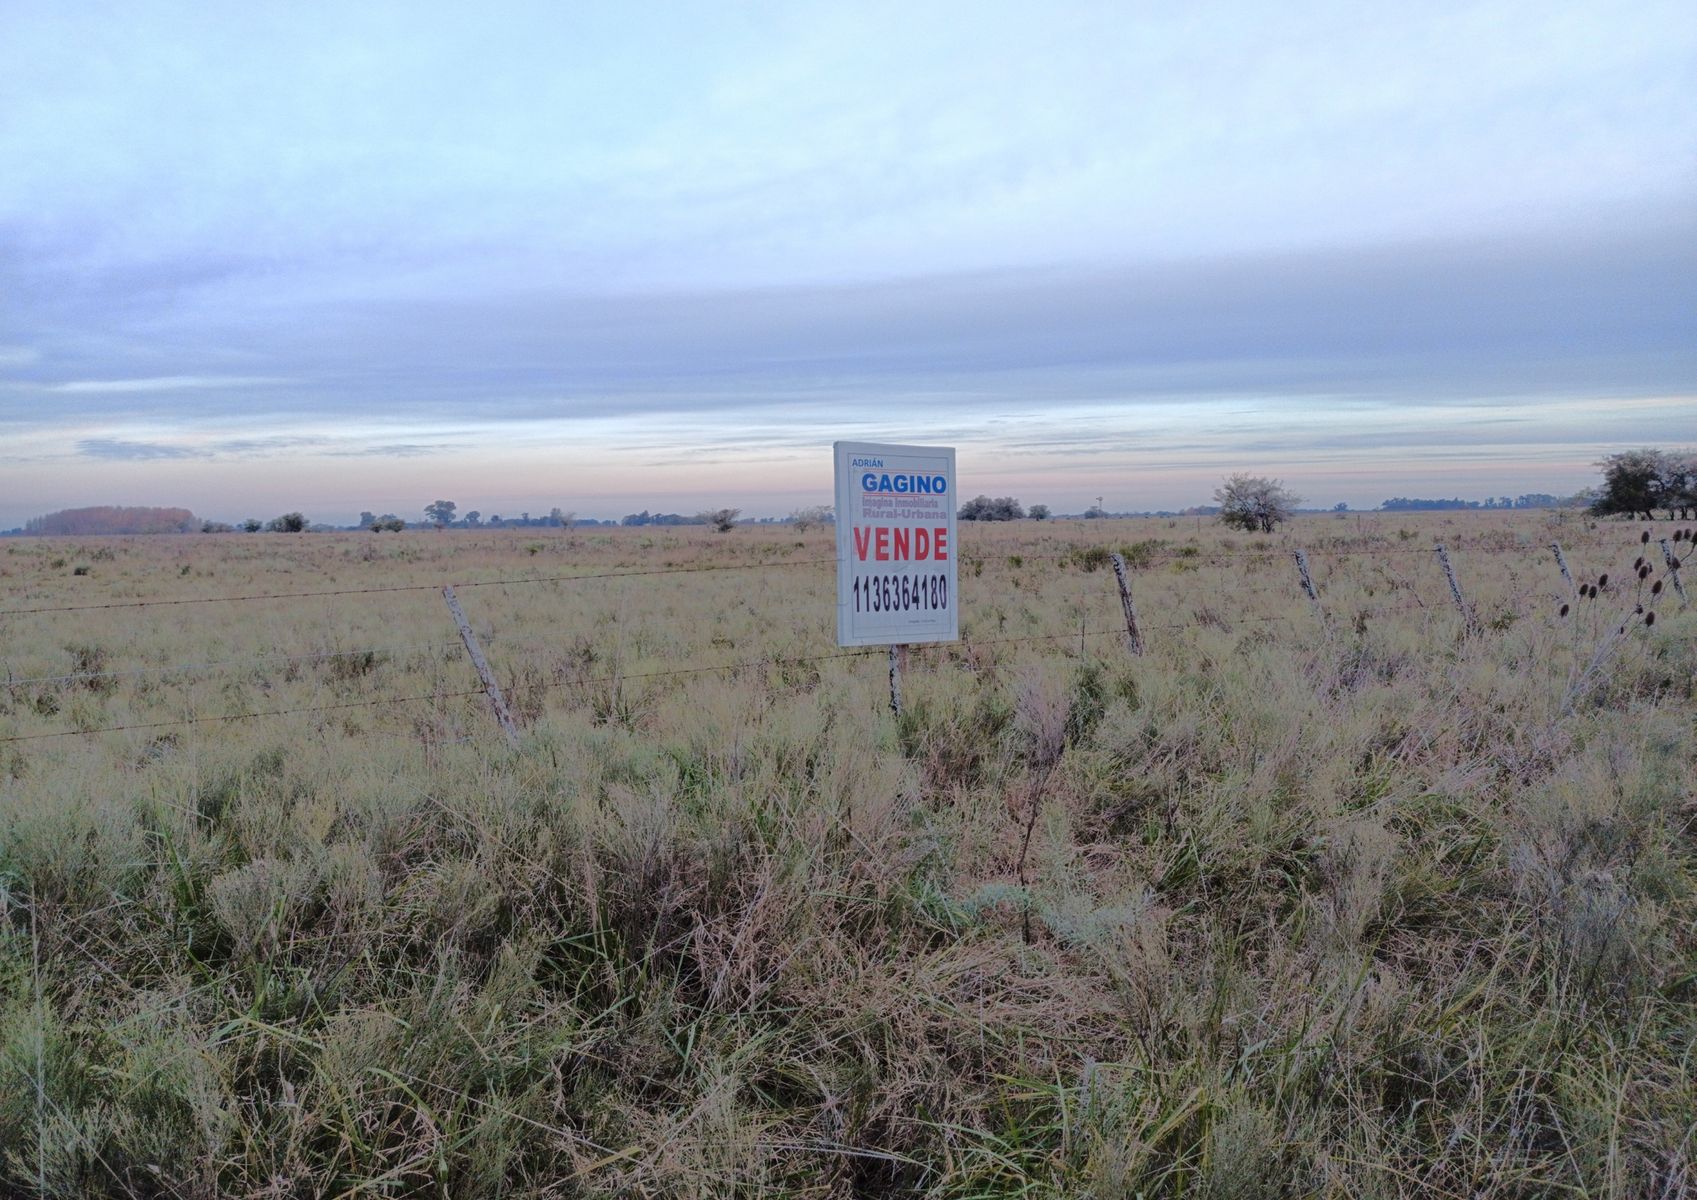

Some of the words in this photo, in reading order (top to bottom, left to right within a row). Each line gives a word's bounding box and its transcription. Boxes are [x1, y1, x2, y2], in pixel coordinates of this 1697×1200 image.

[852, 458, 883, 468] ADRIÁN
[862, 473, 947, 494] GAGINO
[863, 508, 946, 520] Rural-Urbana
[853, 527, 948, 561] VENDE
[853, 574, 947, 613] 1136364180
